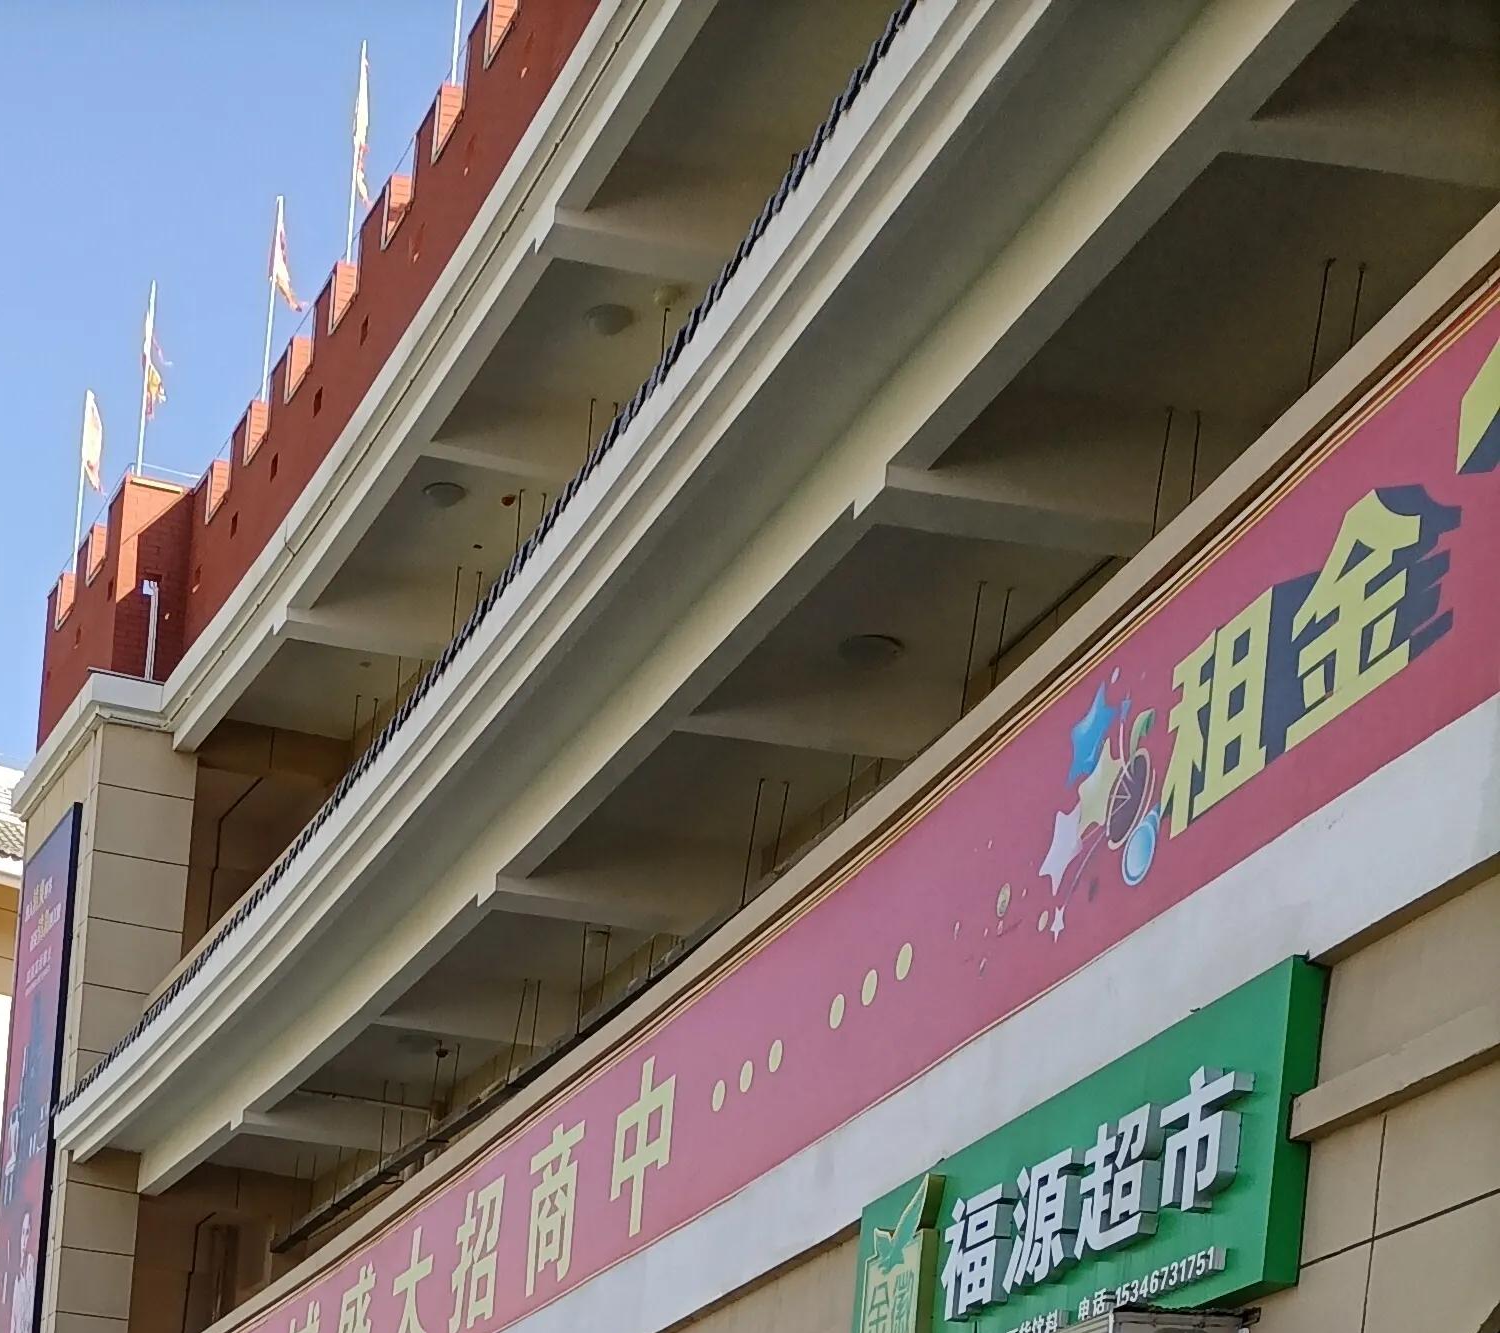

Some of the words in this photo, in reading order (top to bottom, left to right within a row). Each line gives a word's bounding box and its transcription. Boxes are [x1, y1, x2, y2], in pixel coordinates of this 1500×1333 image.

[941, 1066, 1238, 1321] 福源超市
[1114, 1245, 1215, 1308] 15346731751
